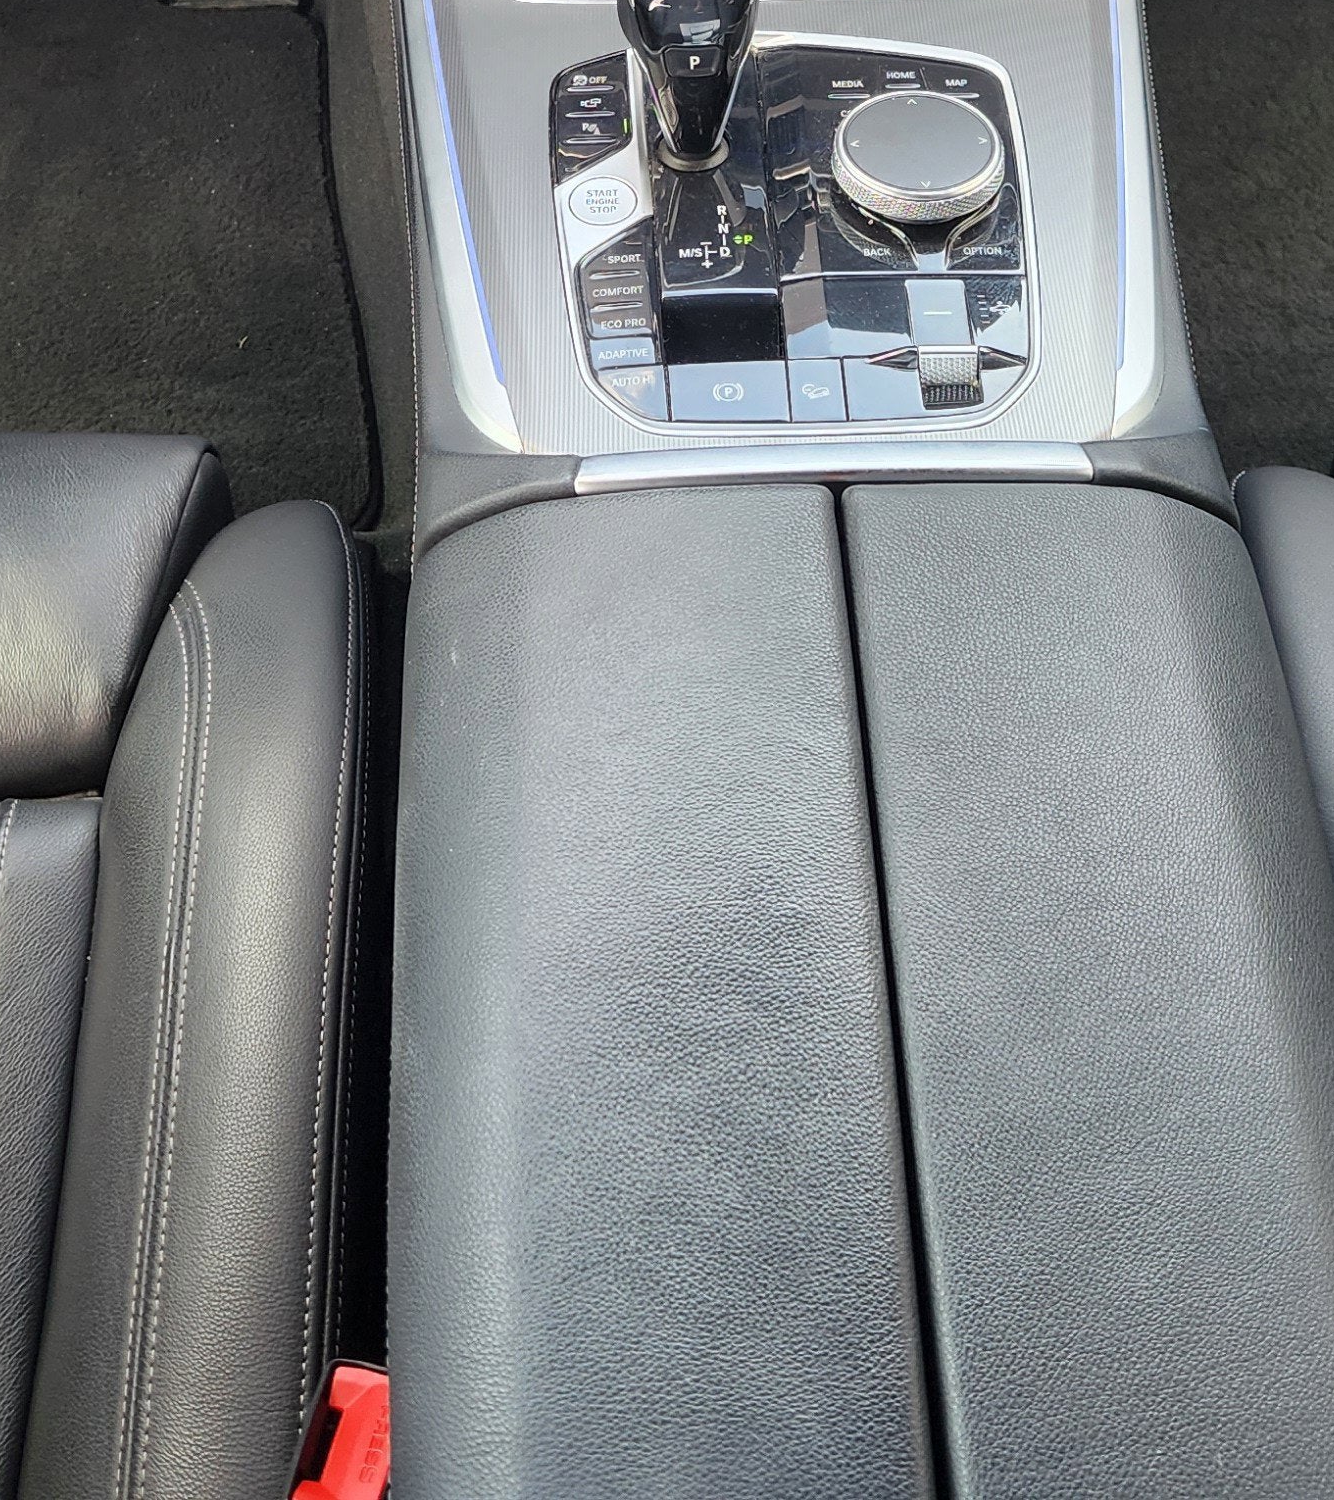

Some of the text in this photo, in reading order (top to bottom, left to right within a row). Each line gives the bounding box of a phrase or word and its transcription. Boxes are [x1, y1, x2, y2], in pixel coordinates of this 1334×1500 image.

[689, 55, 700, 70] P
[588, 75, 608, 84] OFF
[886, 71, 916, 79] HOME
[832, 79, 865, 88] MEDIA
[945, 78, 968, 87] MAP
[586, 189, 618, 197] START
[585, 197, 620, 205] ENGINE
[589, 206, 617, 214] STOP
[717, 205, 727, 215] R
[718, 223, 729, 234] N
[744, 234, 754, 244] P
[678, 247, 731, 258] M/S D
[863, 247, 892, 257] BACK
[963, 247, 1003, 256] OPTION
[607, 253, 642, 264] SPORT
[592, 285, 644, 298] COMFORT
[600, 317, 647, 330] ECO PRO
[598, 348, 649, 361] ADAPTIVE
[611, 376, 640, 387] AUTO
